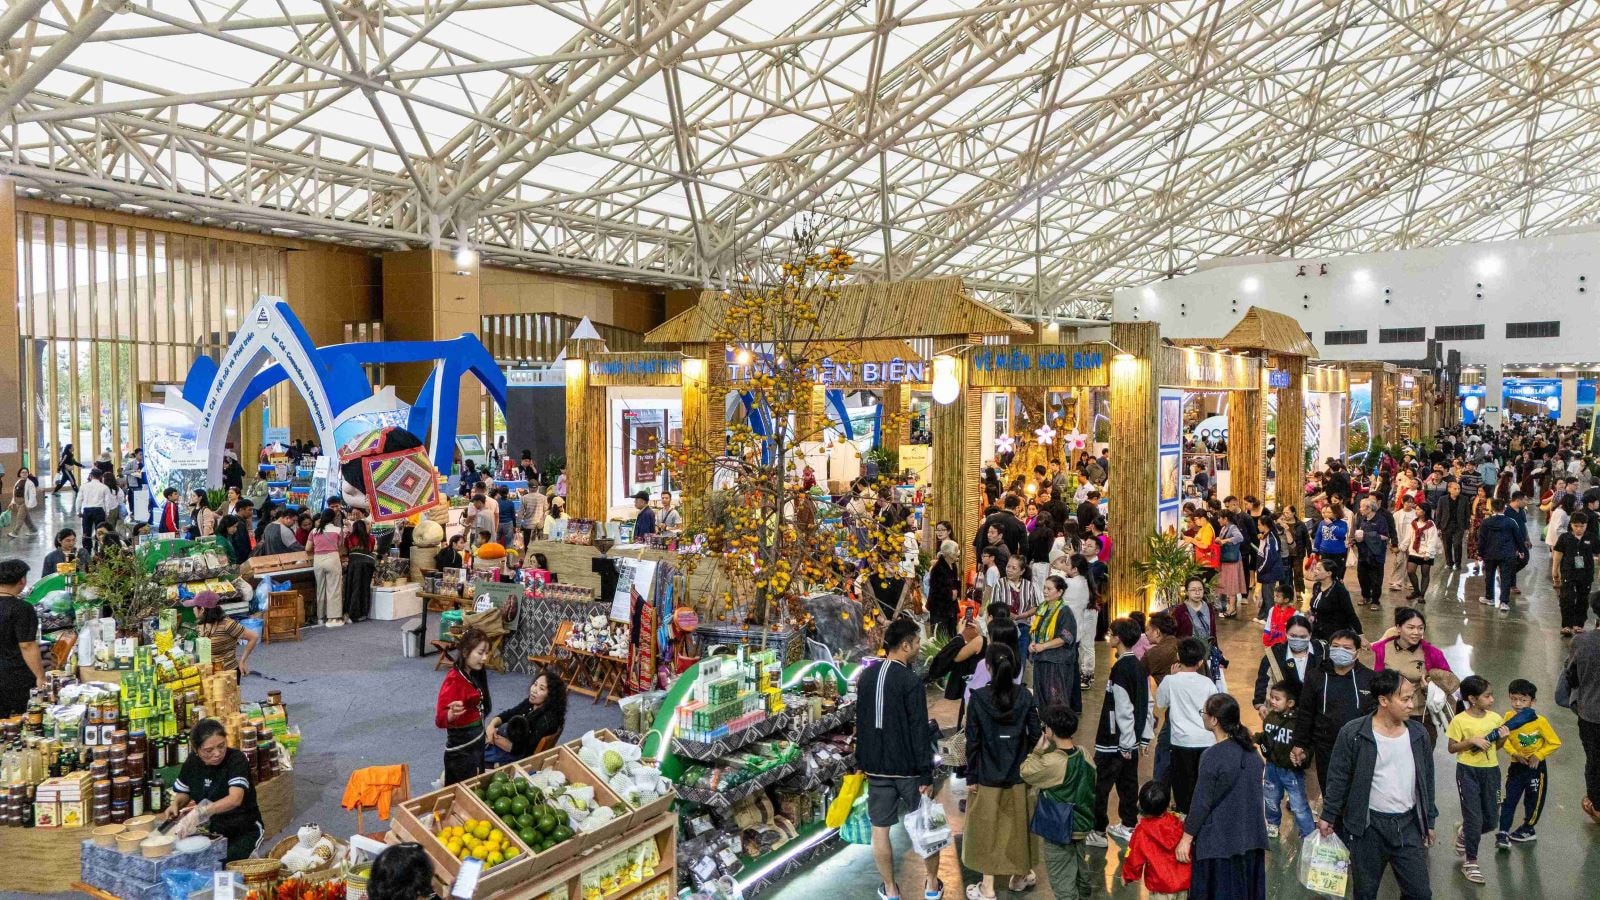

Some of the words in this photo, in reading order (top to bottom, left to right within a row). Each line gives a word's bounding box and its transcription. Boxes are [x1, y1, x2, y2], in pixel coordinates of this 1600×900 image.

[862, 357, 924, 382] BIÊN
[1039, 352, 1066, 370] HOA
[308, 391, 326, 432] Development
